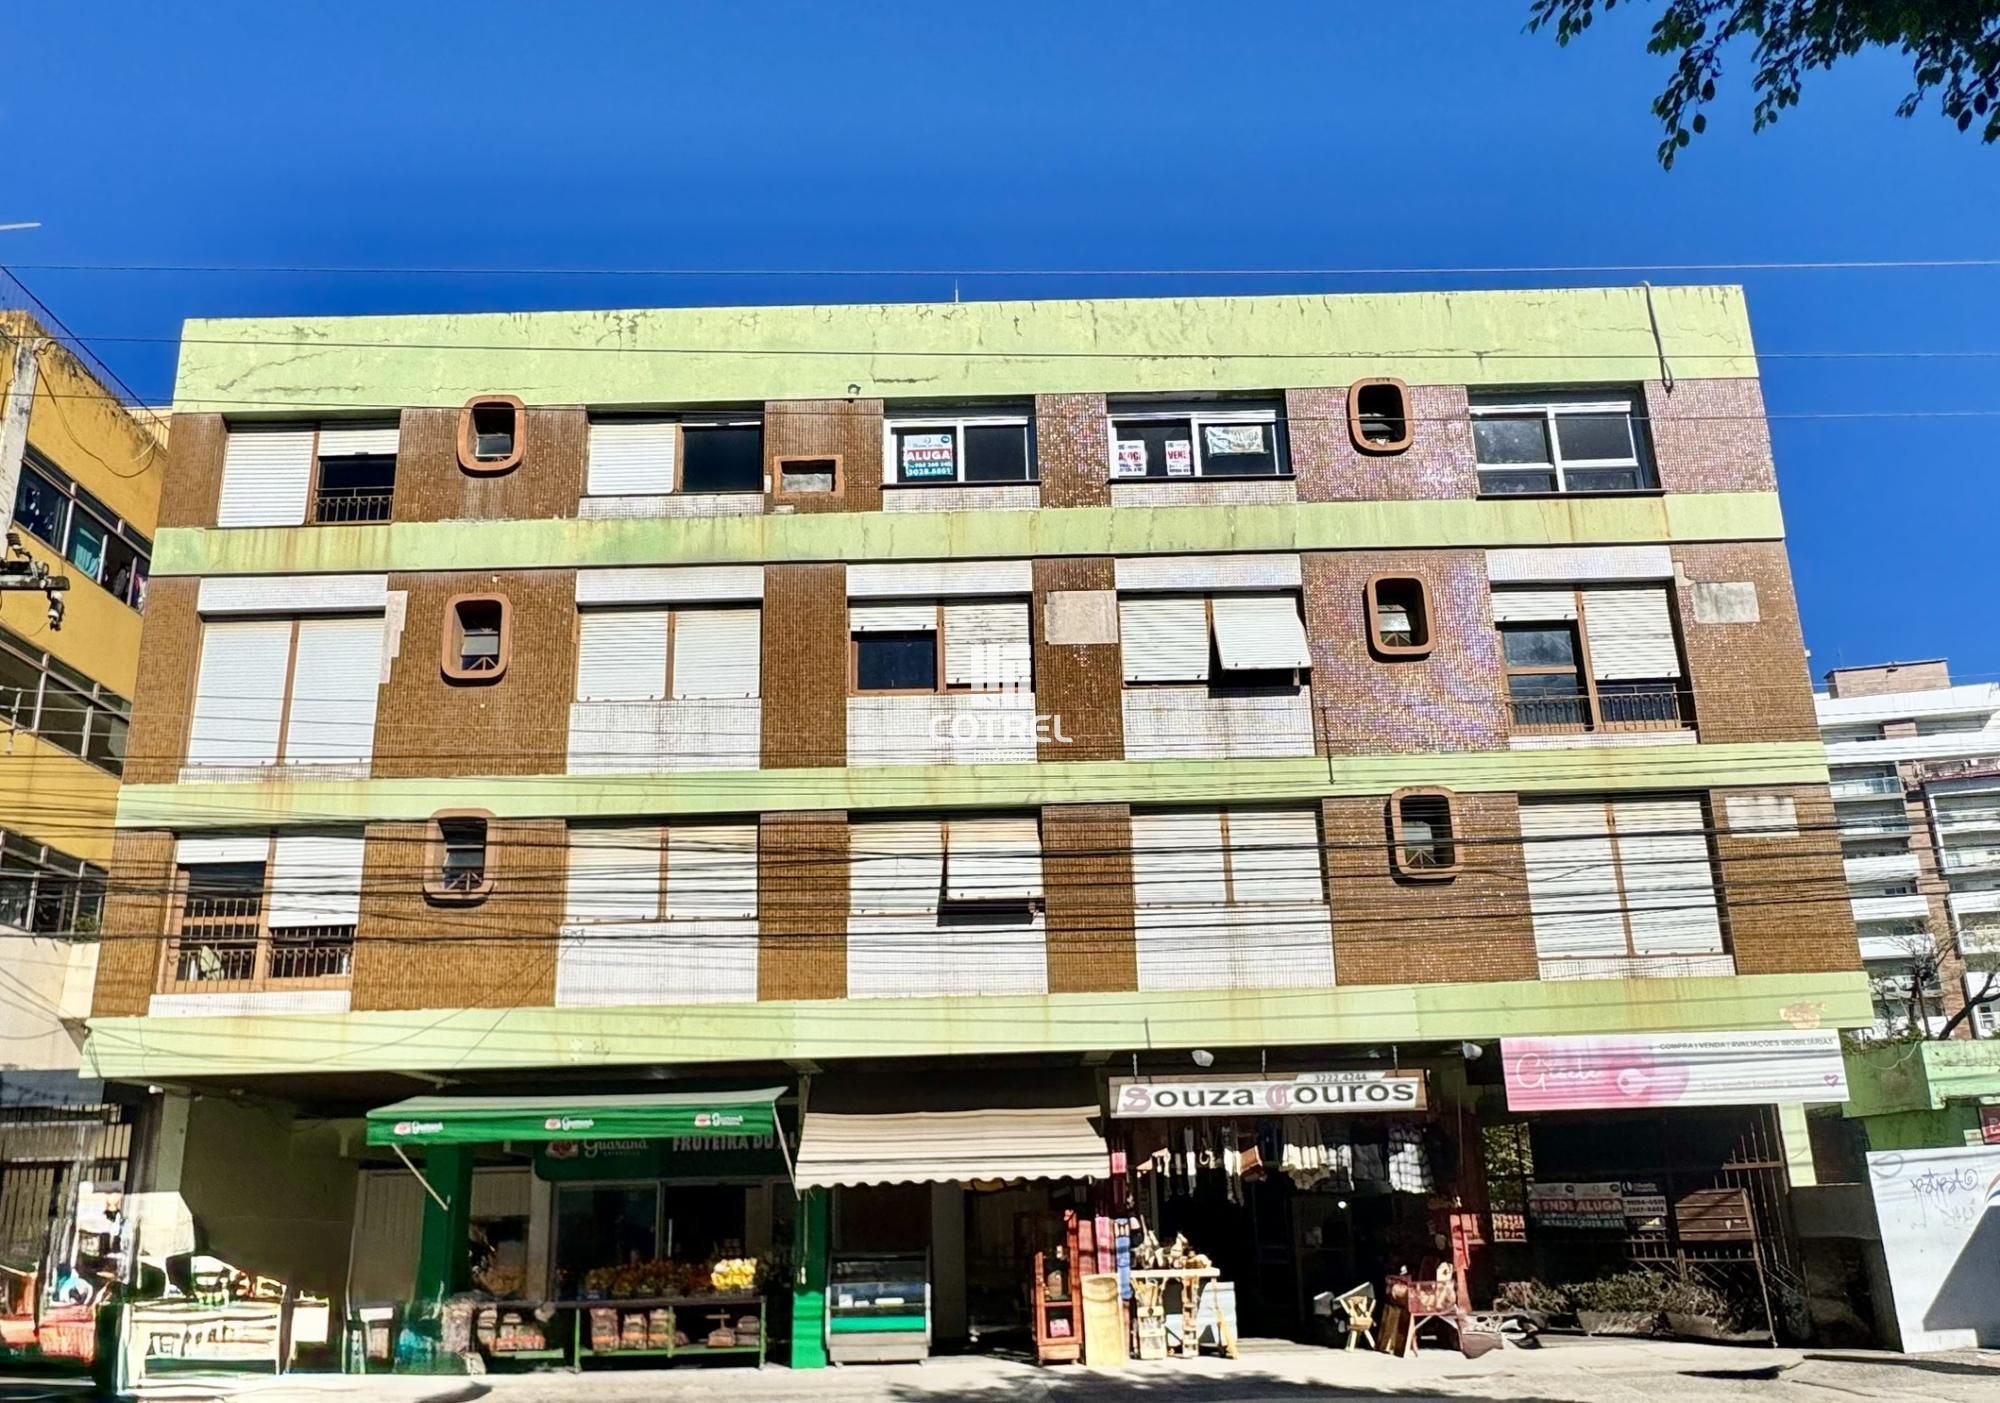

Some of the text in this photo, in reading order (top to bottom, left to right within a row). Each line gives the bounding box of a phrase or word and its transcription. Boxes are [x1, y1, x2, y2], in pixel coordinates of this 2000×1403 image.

[906, 449, 951, 461] ALUGA
[1699, 1041, 1726, 1049] VENDA
[1122, 1080, 1415, 1113] Souza Couros
[672, 1133, 749, 1152] FRUTEIRA
[1576, 1199, 1622, 1212] ALUGA
